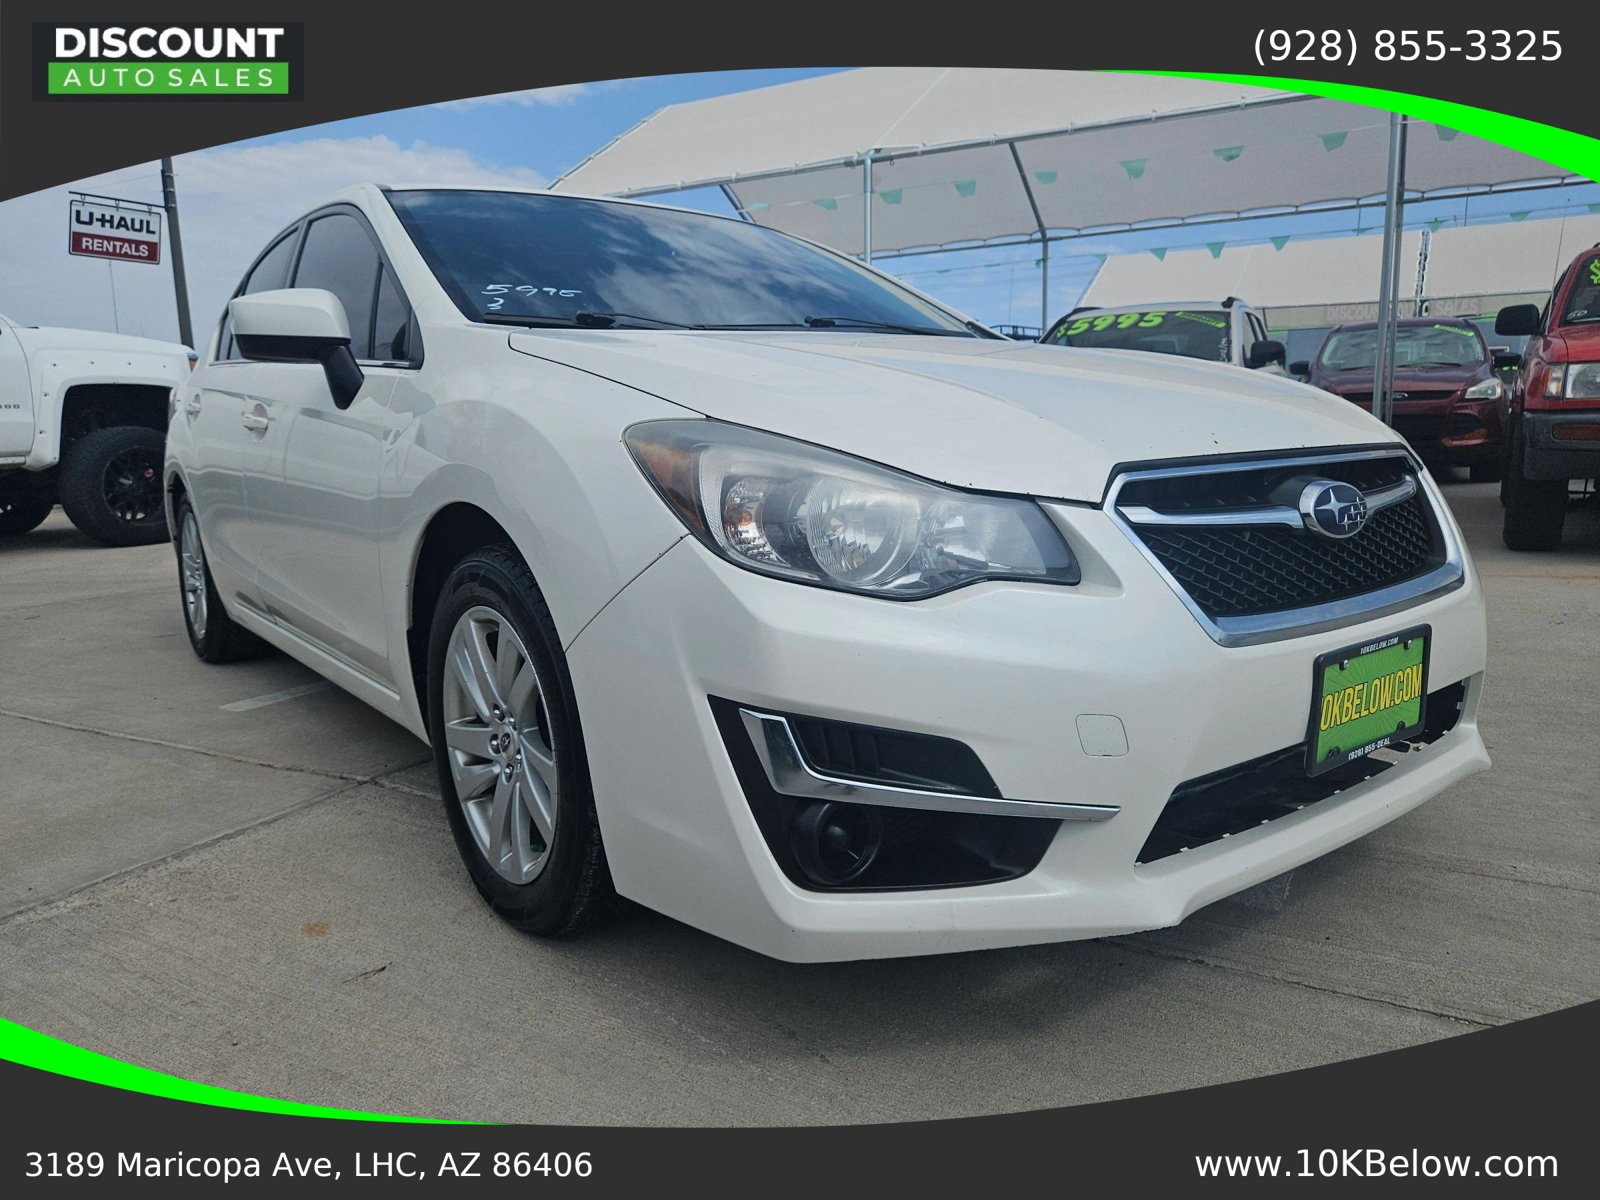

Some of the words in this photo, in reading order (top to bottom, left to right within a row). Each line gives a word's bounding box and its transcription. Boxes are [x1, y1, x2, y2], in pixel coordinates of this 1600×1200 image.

[75, 209, 156, 235] U-HAUL
[82, 237, 149, 257] RENTALS
[1326, 304, 1380, 321] DISCOUN
[1056, 311, 1167, 338] $5995
